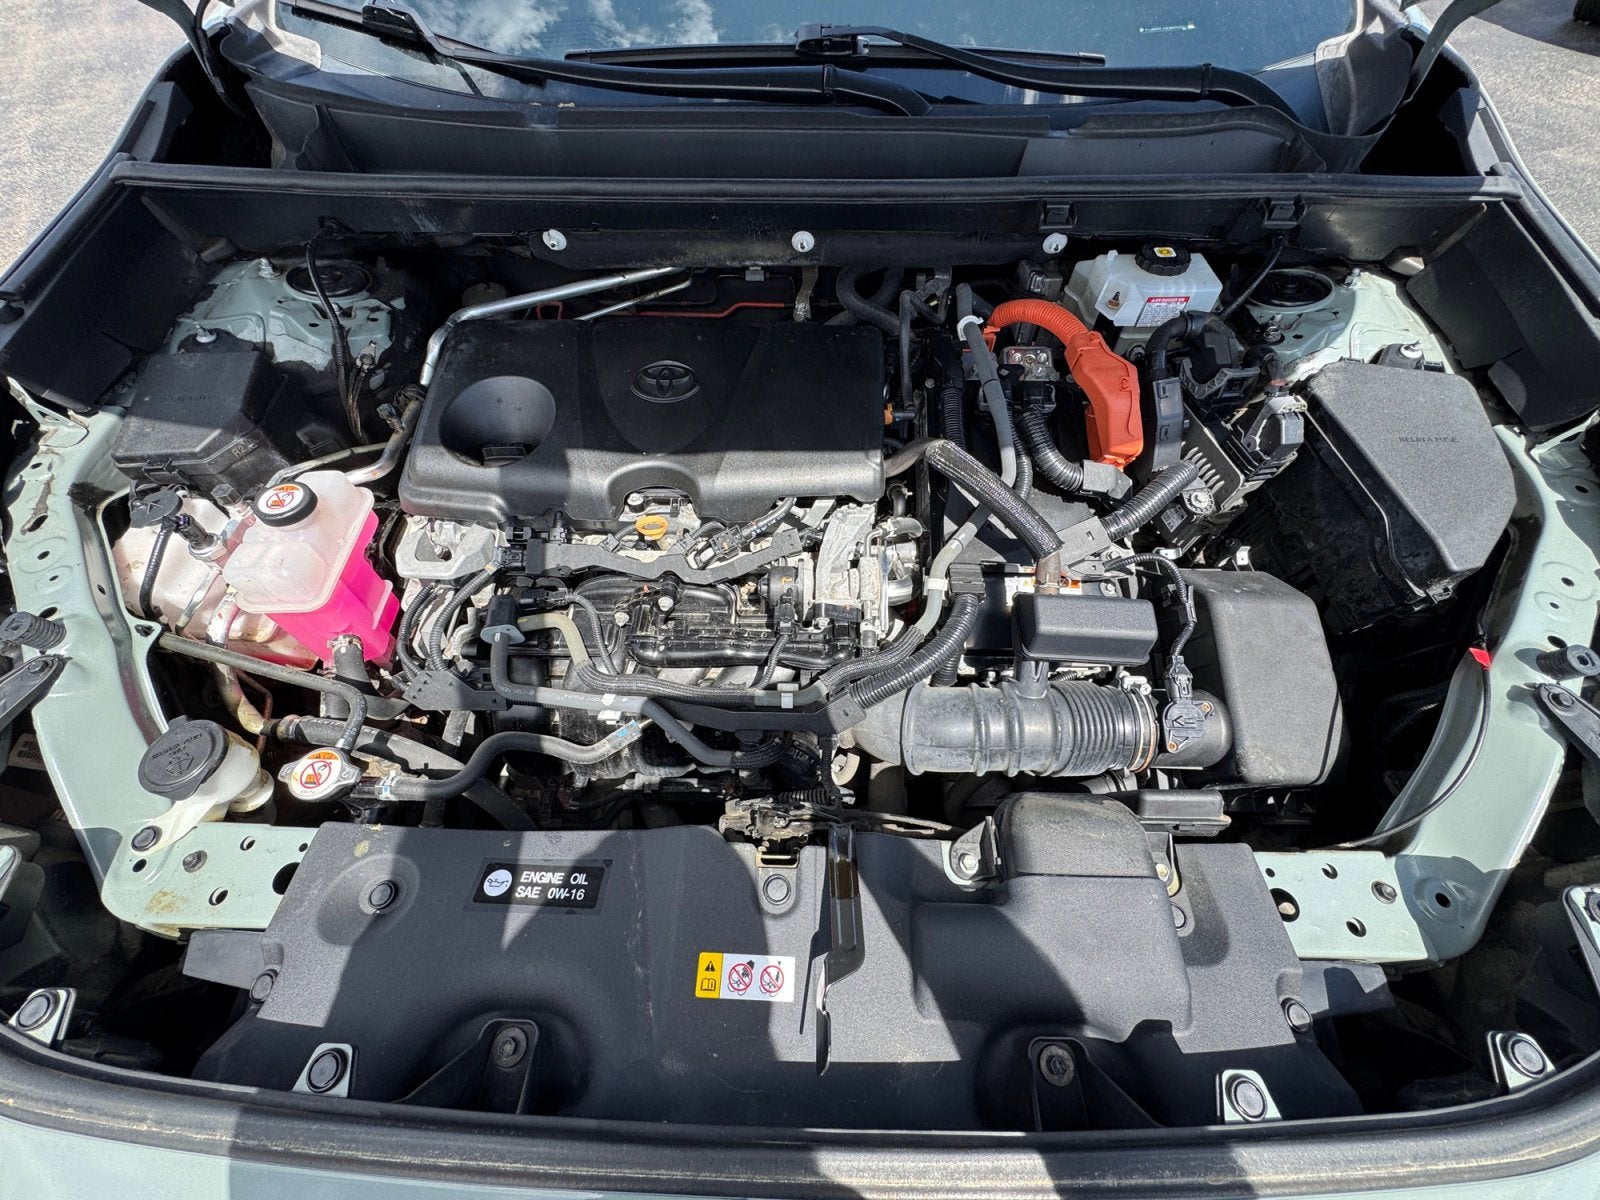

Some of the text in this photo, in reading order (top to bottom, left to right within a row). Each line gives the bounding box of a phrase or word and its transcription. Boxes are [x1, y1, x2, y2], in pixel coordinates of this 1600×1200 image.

[232, 445, 247, 458] R2
[520, 871, 588, 885] ENGINE OIL
[515, 885, 585, 900] SAE 0W-16
